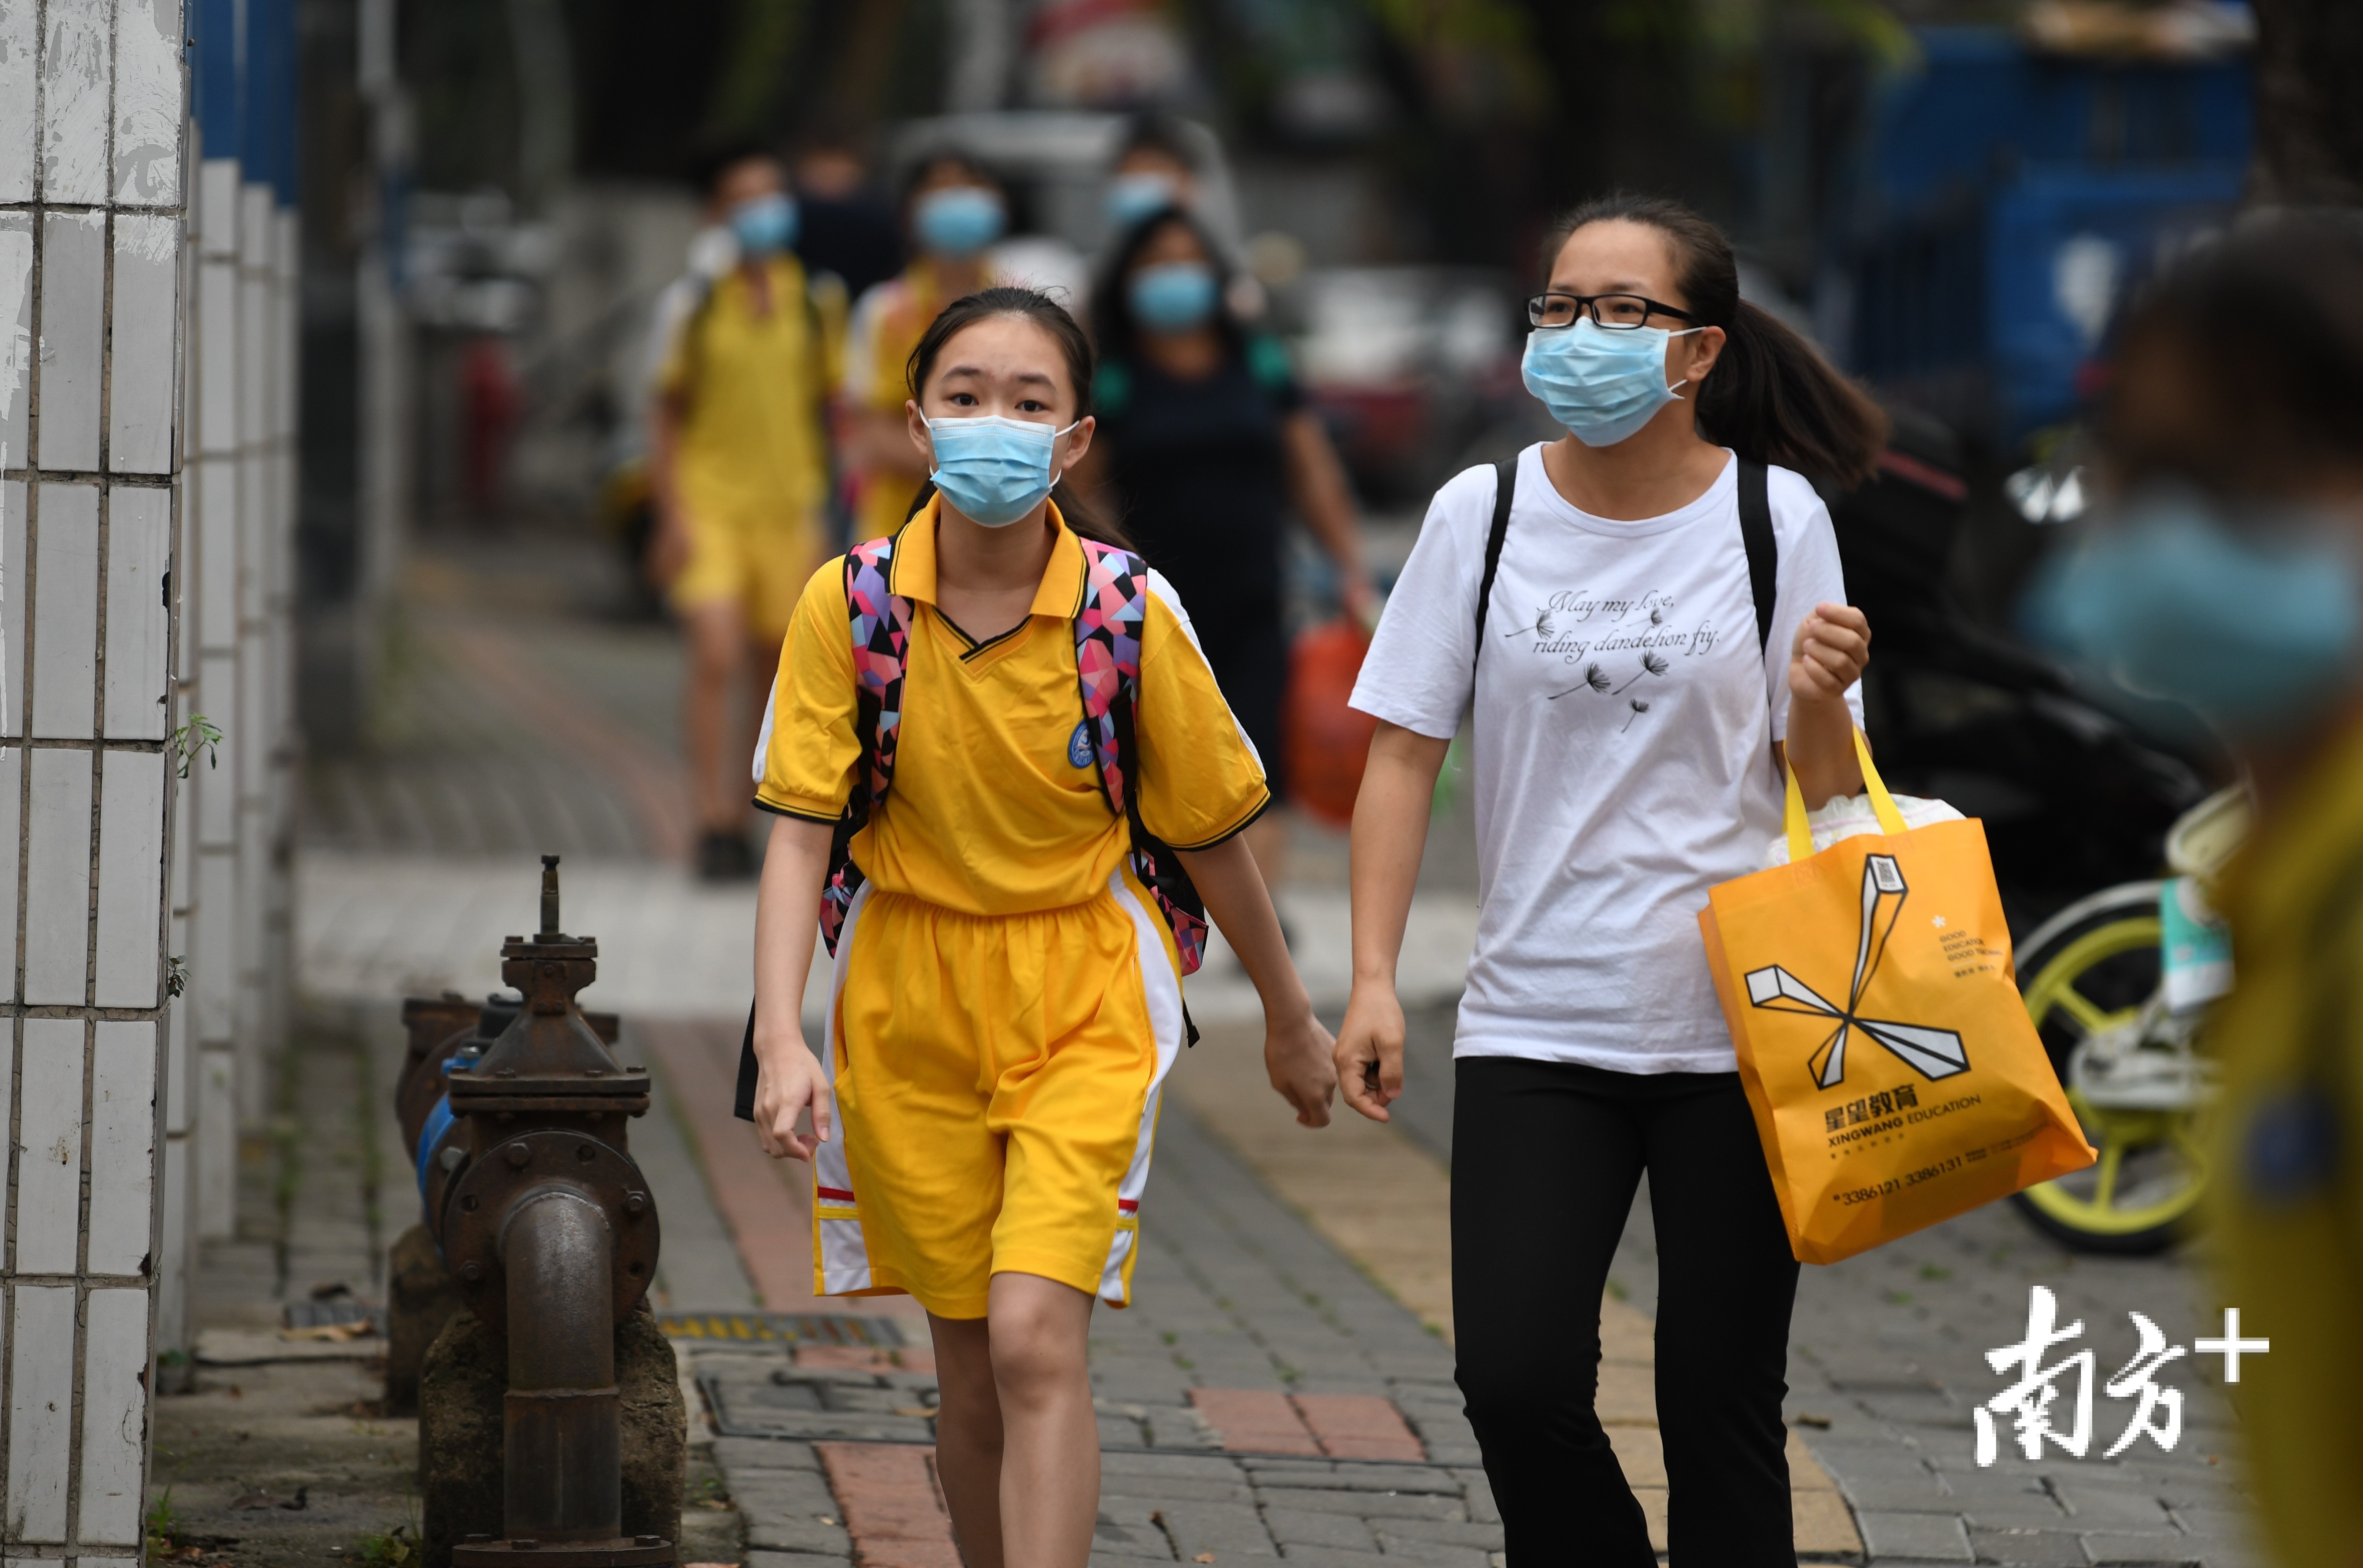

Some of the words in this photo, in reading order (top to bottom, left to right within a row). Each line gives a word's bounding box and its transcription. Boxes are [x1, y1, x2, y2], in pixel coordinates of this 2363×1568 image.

[1548, 589, 1601, 623] May
[1601, 600, 1634, 623] my
[1635, 589, 1674, 610] love,
[1533, 630, 1589, 664] riding
[1594, 625, 1687, 652] dandelion
[1824, 1084, 1919, 1133] 星望教育
[1828, 1116, 1904, 1148] XINGWANG
[1906, 1094, 1982, 1125] EDUCATION
[1842, 1178, 1901, 1206] 3386121
[1906, 1156, 1963, 1187] 3386131
